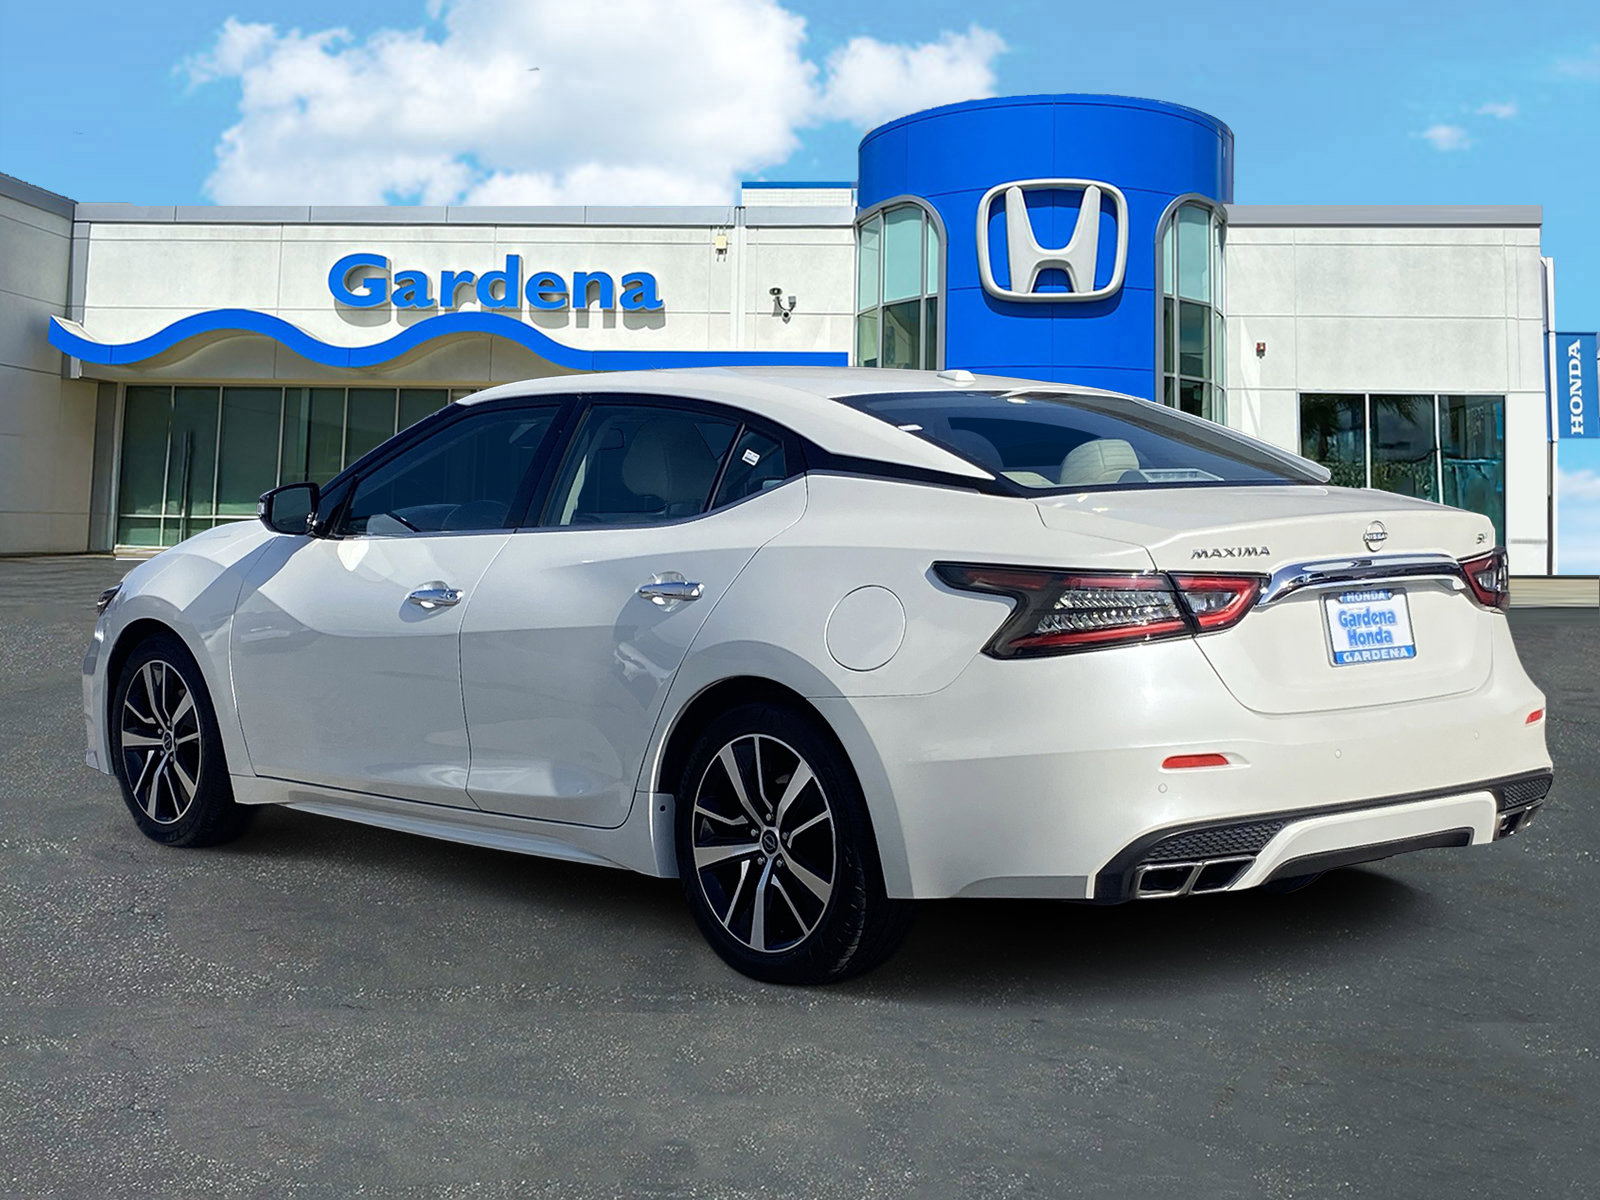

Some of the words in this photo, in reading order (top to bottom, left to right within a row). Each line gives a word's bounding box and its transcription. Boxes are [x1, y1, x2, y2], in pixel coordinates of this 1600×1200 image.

[328, 253, 663, 310] Gardena
[1568, 339, 1584, 435] HONDA
[1191, 546, 1270, 559] MAXIMA
[1346, 591, 1386, 602] HONDA
[1338, 607, 1396, 628] Gardena
[1347, 627, 1393, 646] Honda
[1343, 647, 1408, 662] GARDENA
